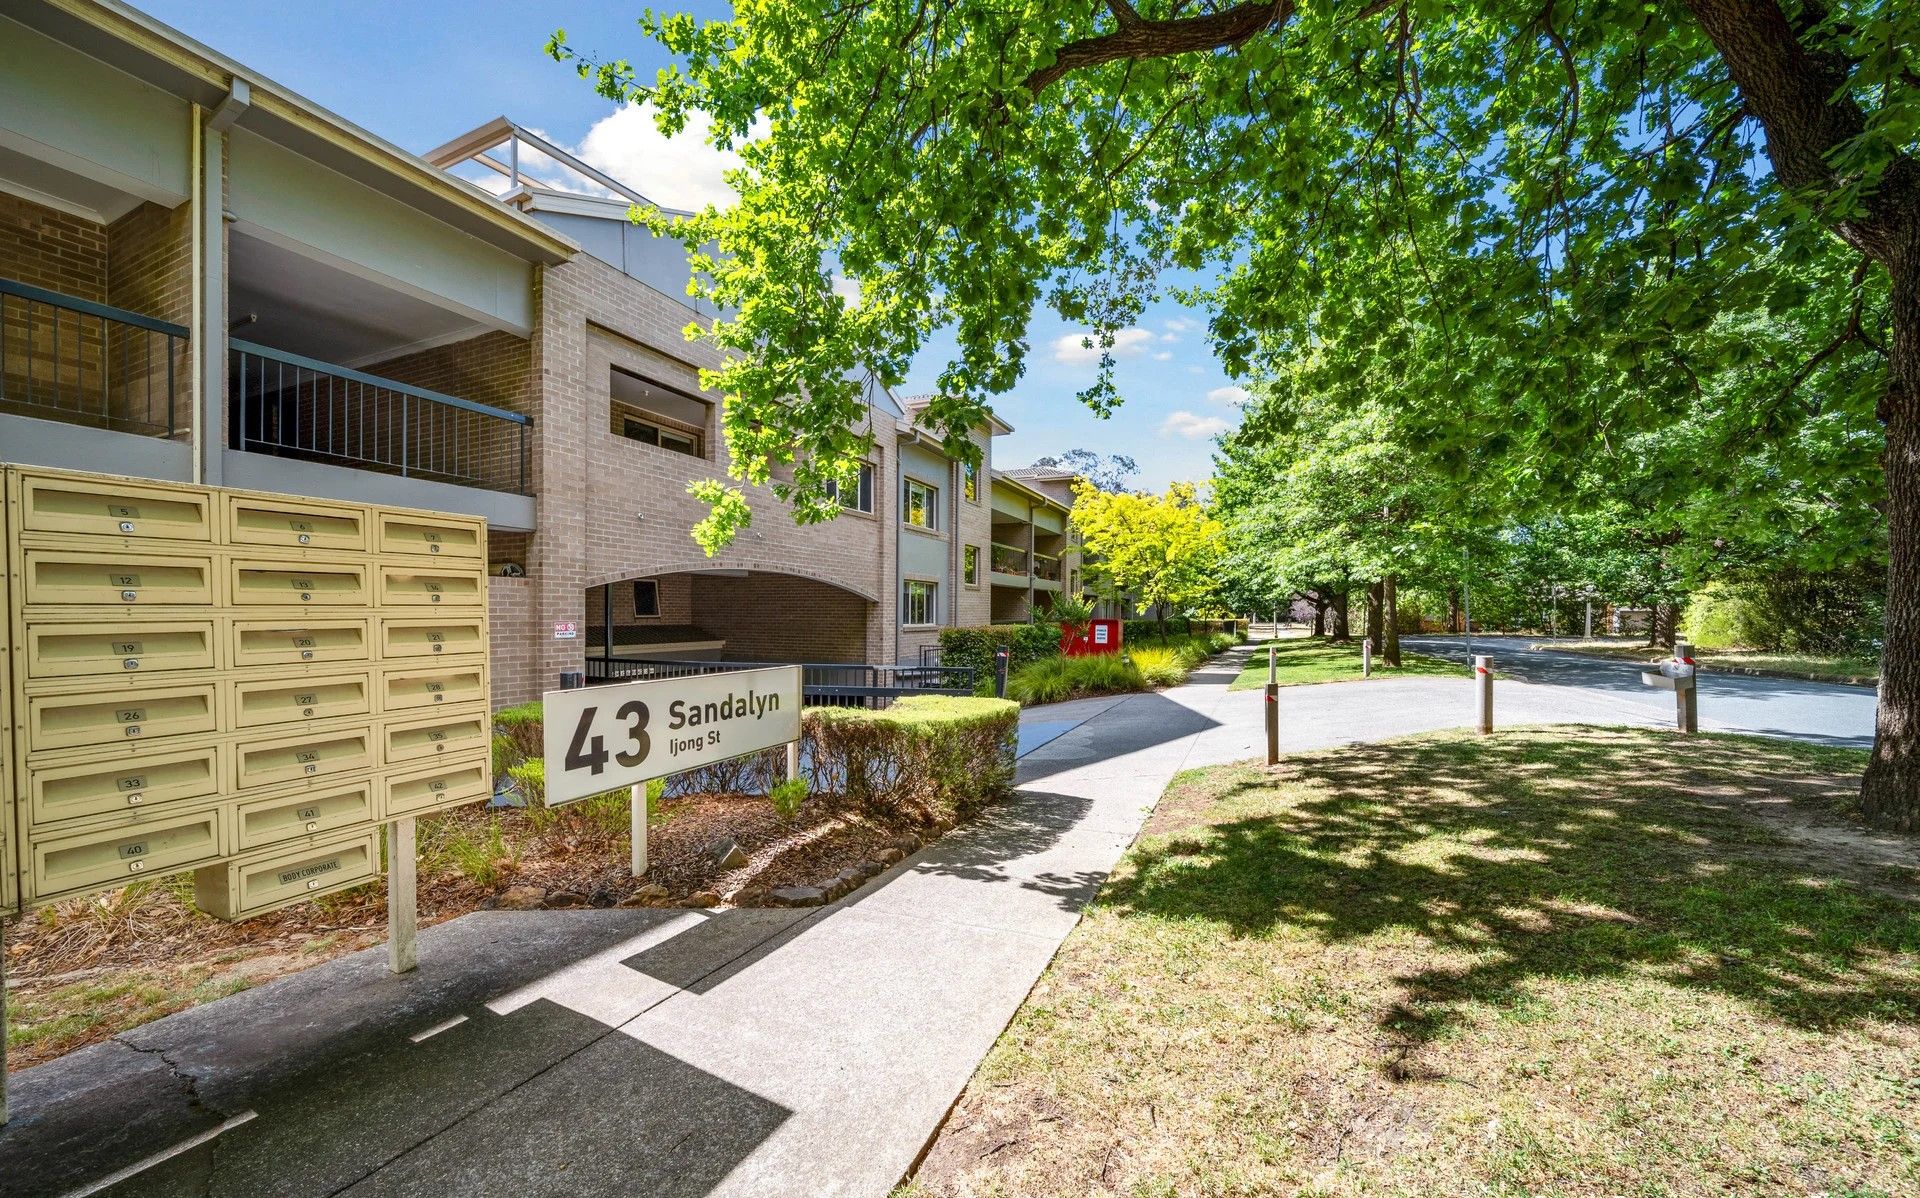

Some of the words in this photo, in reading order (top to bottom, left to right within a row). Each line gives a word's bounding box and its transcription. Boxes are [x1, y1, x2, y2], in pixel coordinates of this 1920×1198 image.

[120, 507, 129, 516] 5
[119, 576, 133, 585] 12
[299, 580, 309, 589] 13
[300, 639, 311, 647] 20
[122, 644, 135, 653] 19
[301, 696, 312, 705] 27
[668, 690, 780, 730] Sandalyn
[124, 711, 140, 721] 26
[433, 732, 443, 740] 35
[564, 700, 651, 776] 43
[669, 735, 703, 757] Ijong
[707, 730, 721, 744] St
[303, 752, 315, 762] 34
[124, 778, 141, 789] 33
[434, 782, 443, 790] 42
[304, 809, 315, 818] 41
[126, 845, 142, 856] 40
[282, 870, 301, 883] BODY
[301, 862, 338, 877] CORPORATE
